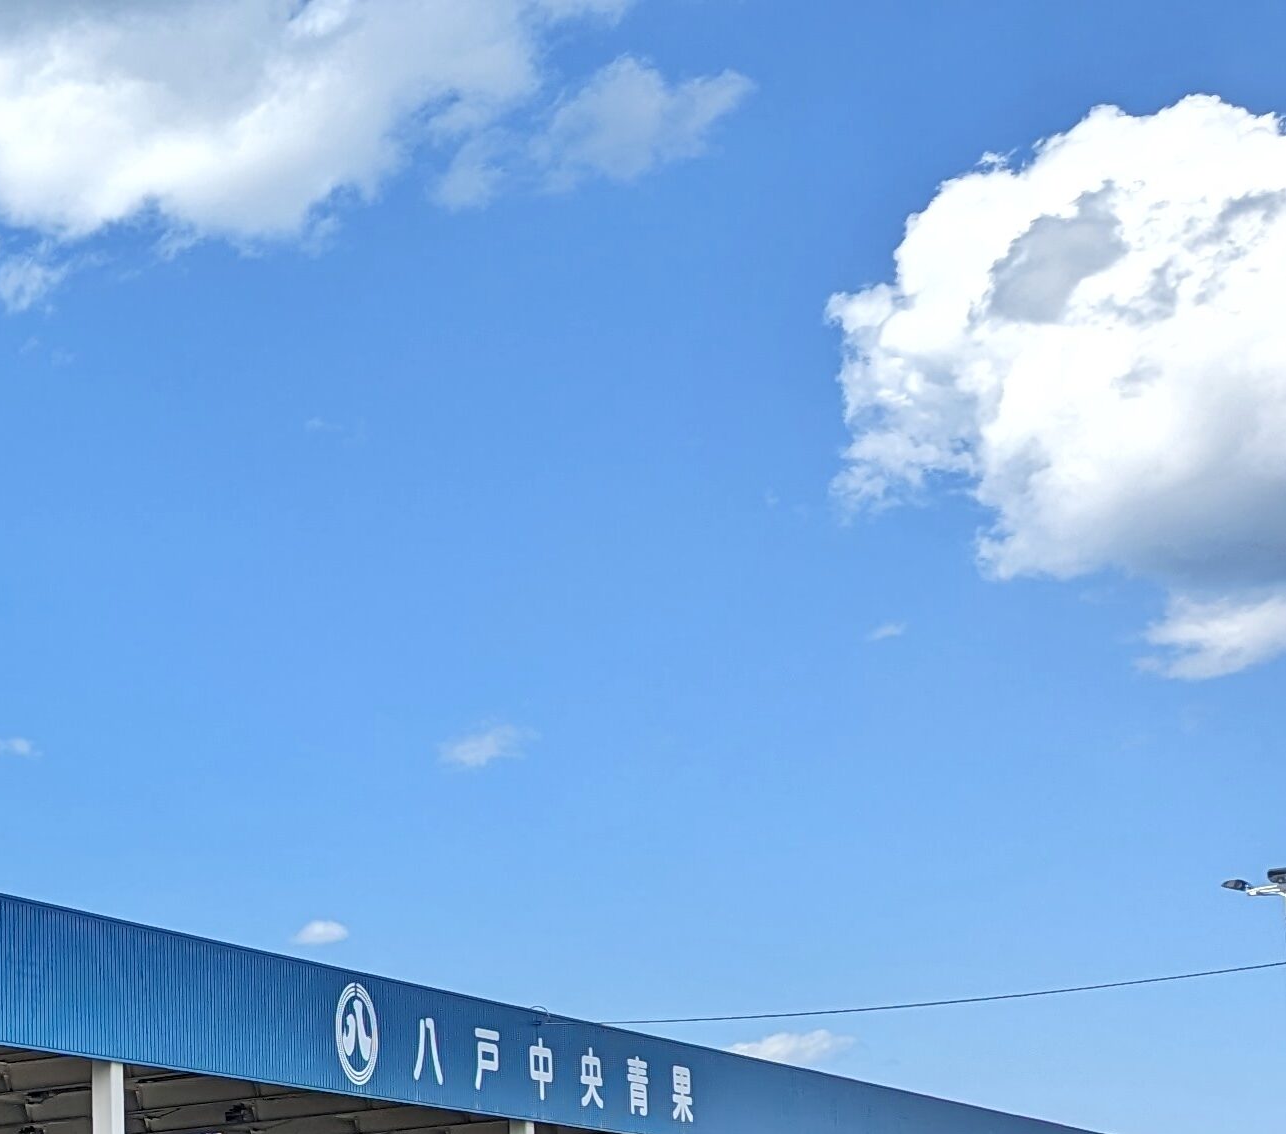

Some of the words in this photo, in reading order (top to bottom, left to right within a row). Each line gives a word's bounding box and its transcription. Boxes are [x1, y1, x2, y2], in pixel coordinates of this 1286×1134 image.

[413, 1017, 694, 1124] 八戸中央青果
